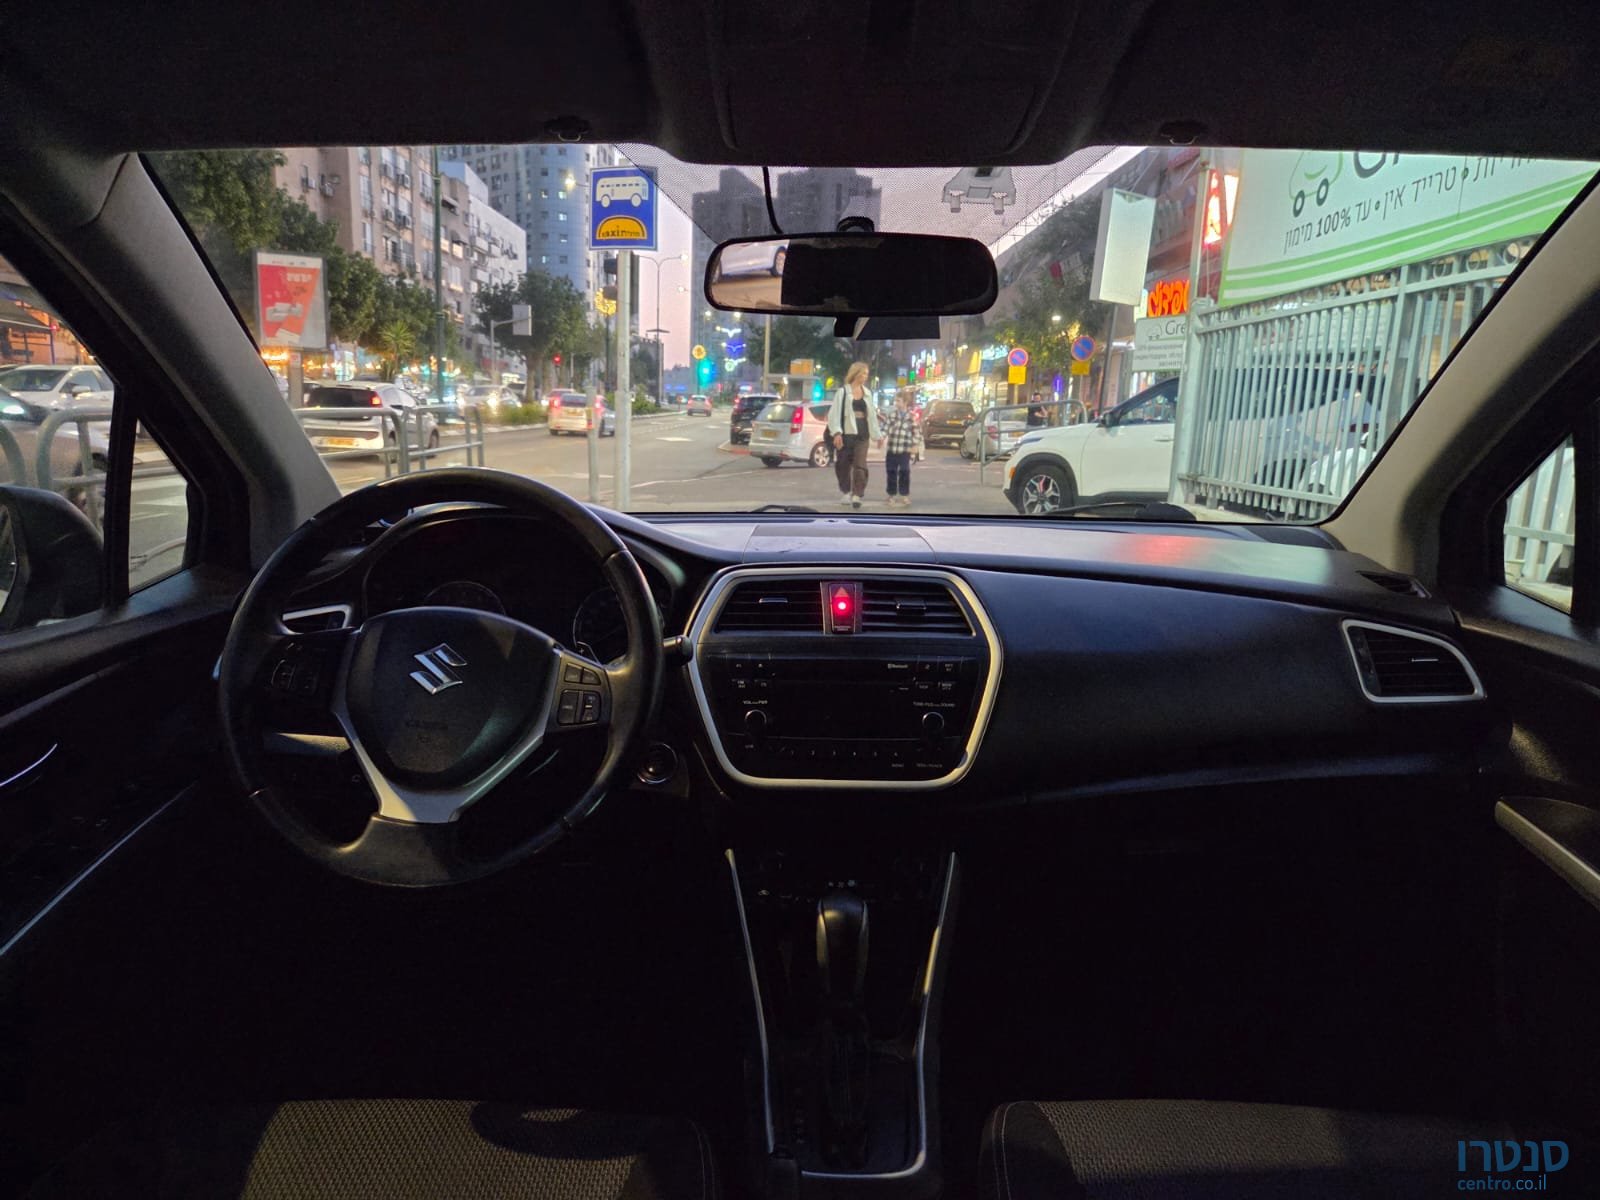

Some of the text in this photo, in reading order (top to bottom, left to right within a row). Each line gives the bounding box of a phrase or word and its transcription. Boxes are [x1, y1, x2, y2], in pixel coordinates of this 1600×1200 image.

[1411, 166, 1457, 203] טרייד
[1355, 198, 1372, 223] עד
[1383, 184, 1406, 221] אין
[1283, 222, 1313, 256] מימון
[1315, 206, 1351, 239] 100%
